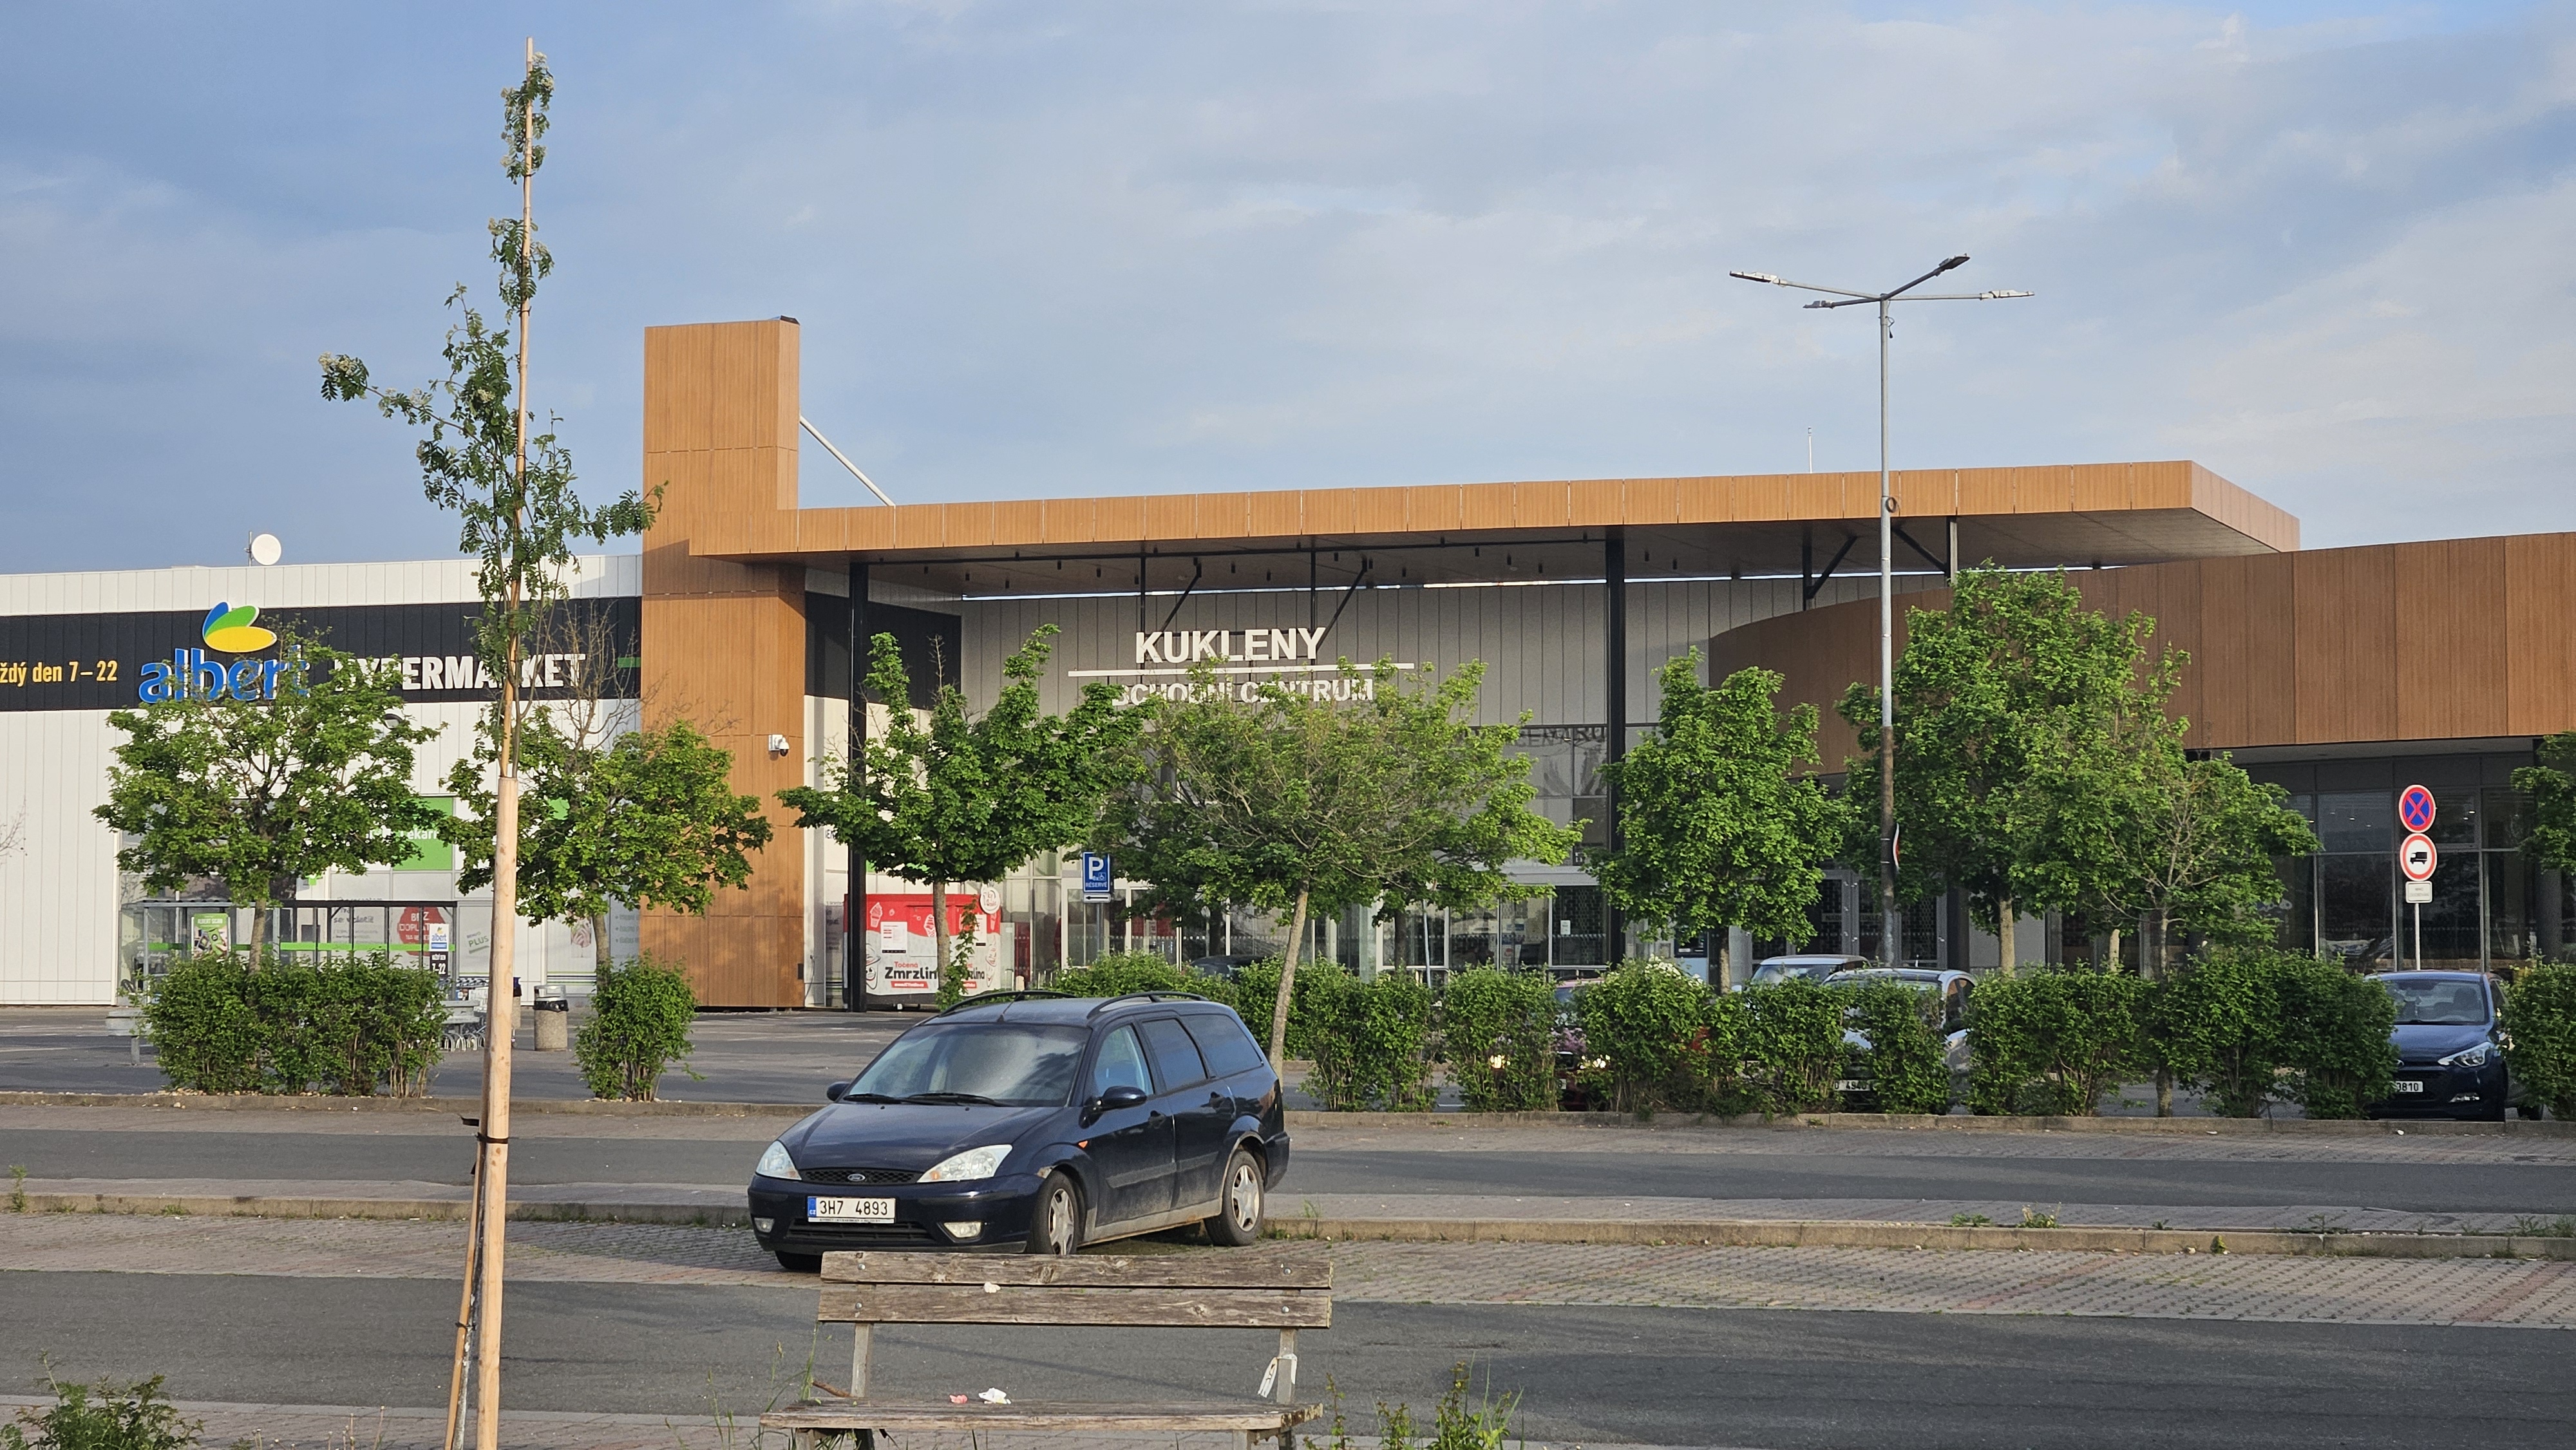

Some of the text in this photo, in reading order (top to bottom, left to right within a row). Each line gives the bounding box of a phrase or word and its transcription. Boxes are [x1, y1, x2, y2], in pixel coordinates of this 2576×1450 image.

[1135, 627, 1326, 664] KUKLENY
[32, 661, 62, 683] den
[138, 645, 310, 704] albert
[334, 653, 587, 692] YPERMAKET
[1088, 856, 1104, 880] P
[431, 933, 447, 941] albert
[468, 936, 489, 947] PLUS
[884, 966, 937, 979] Zmrzlin
[819, 1200, 844, 1215] 3H7
[855, 1200, 887, 1216] 4893
